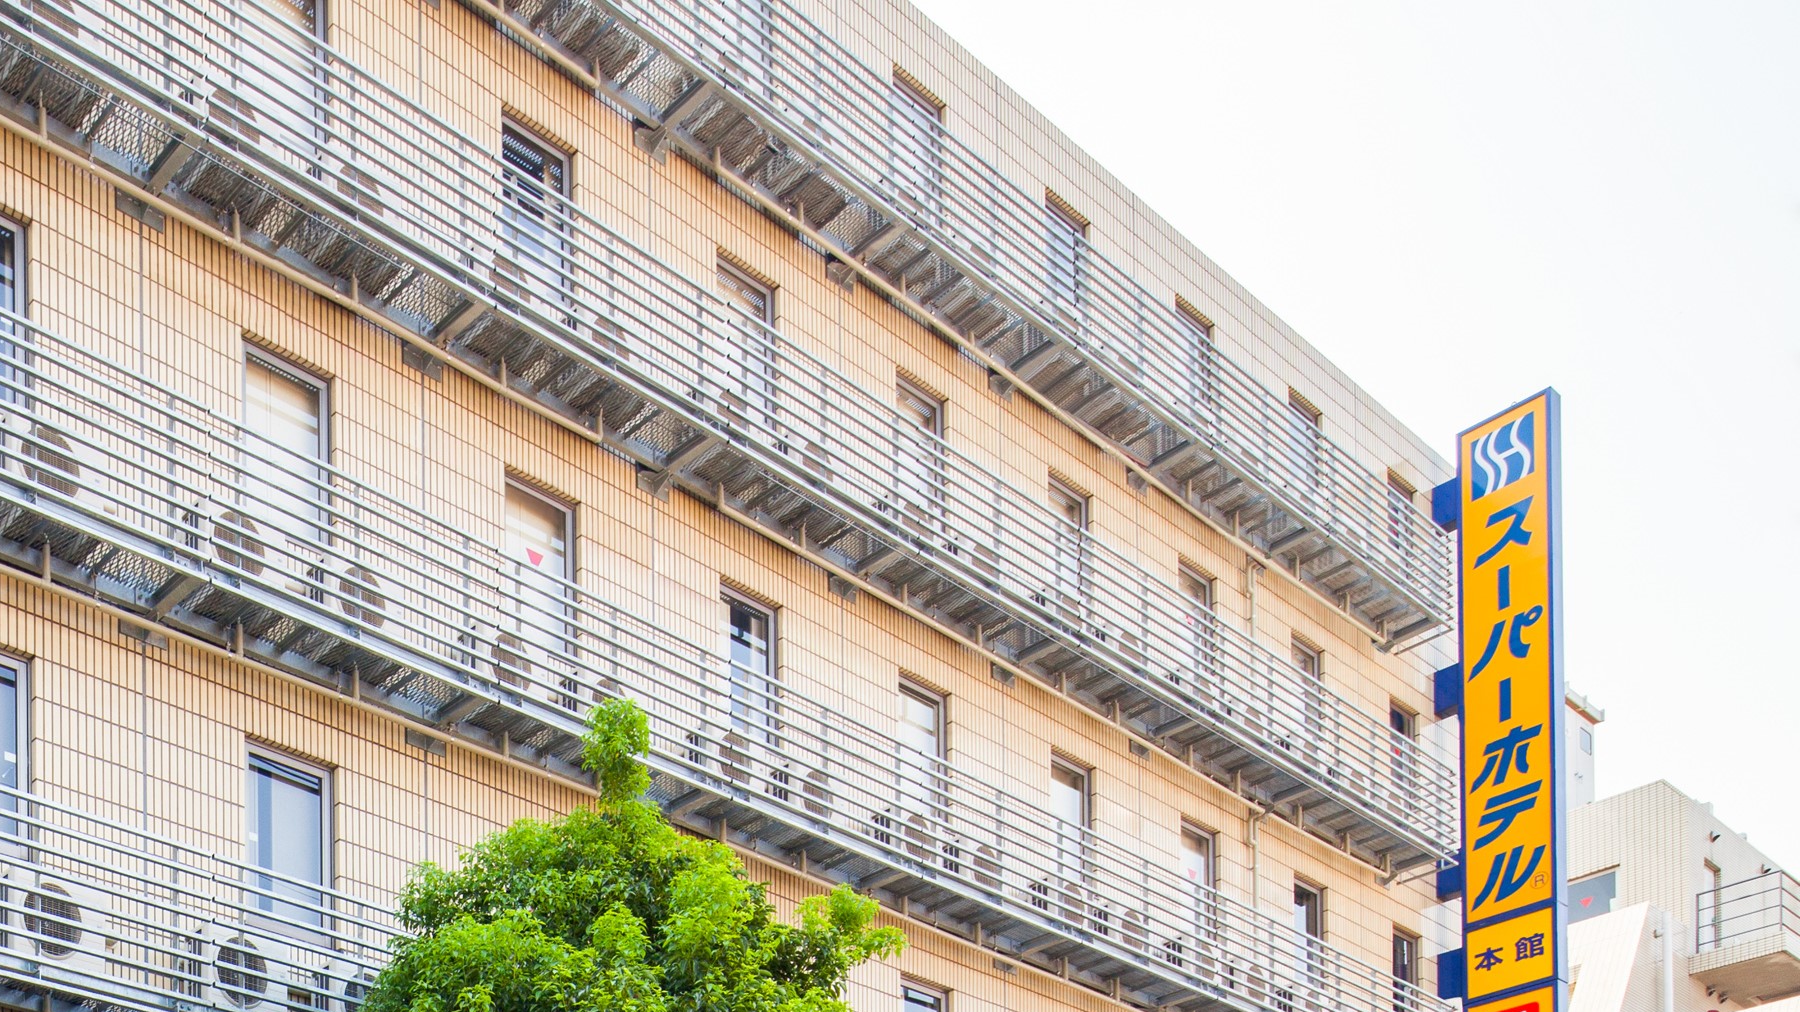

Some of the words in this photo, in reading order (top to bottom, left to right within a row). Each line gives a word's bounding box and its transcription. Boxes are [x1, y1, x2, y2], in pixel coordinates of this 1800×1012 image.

[1468, 495, 1546, 912] スーパーホテル
[1474, 932, 1545, 971] 本館
